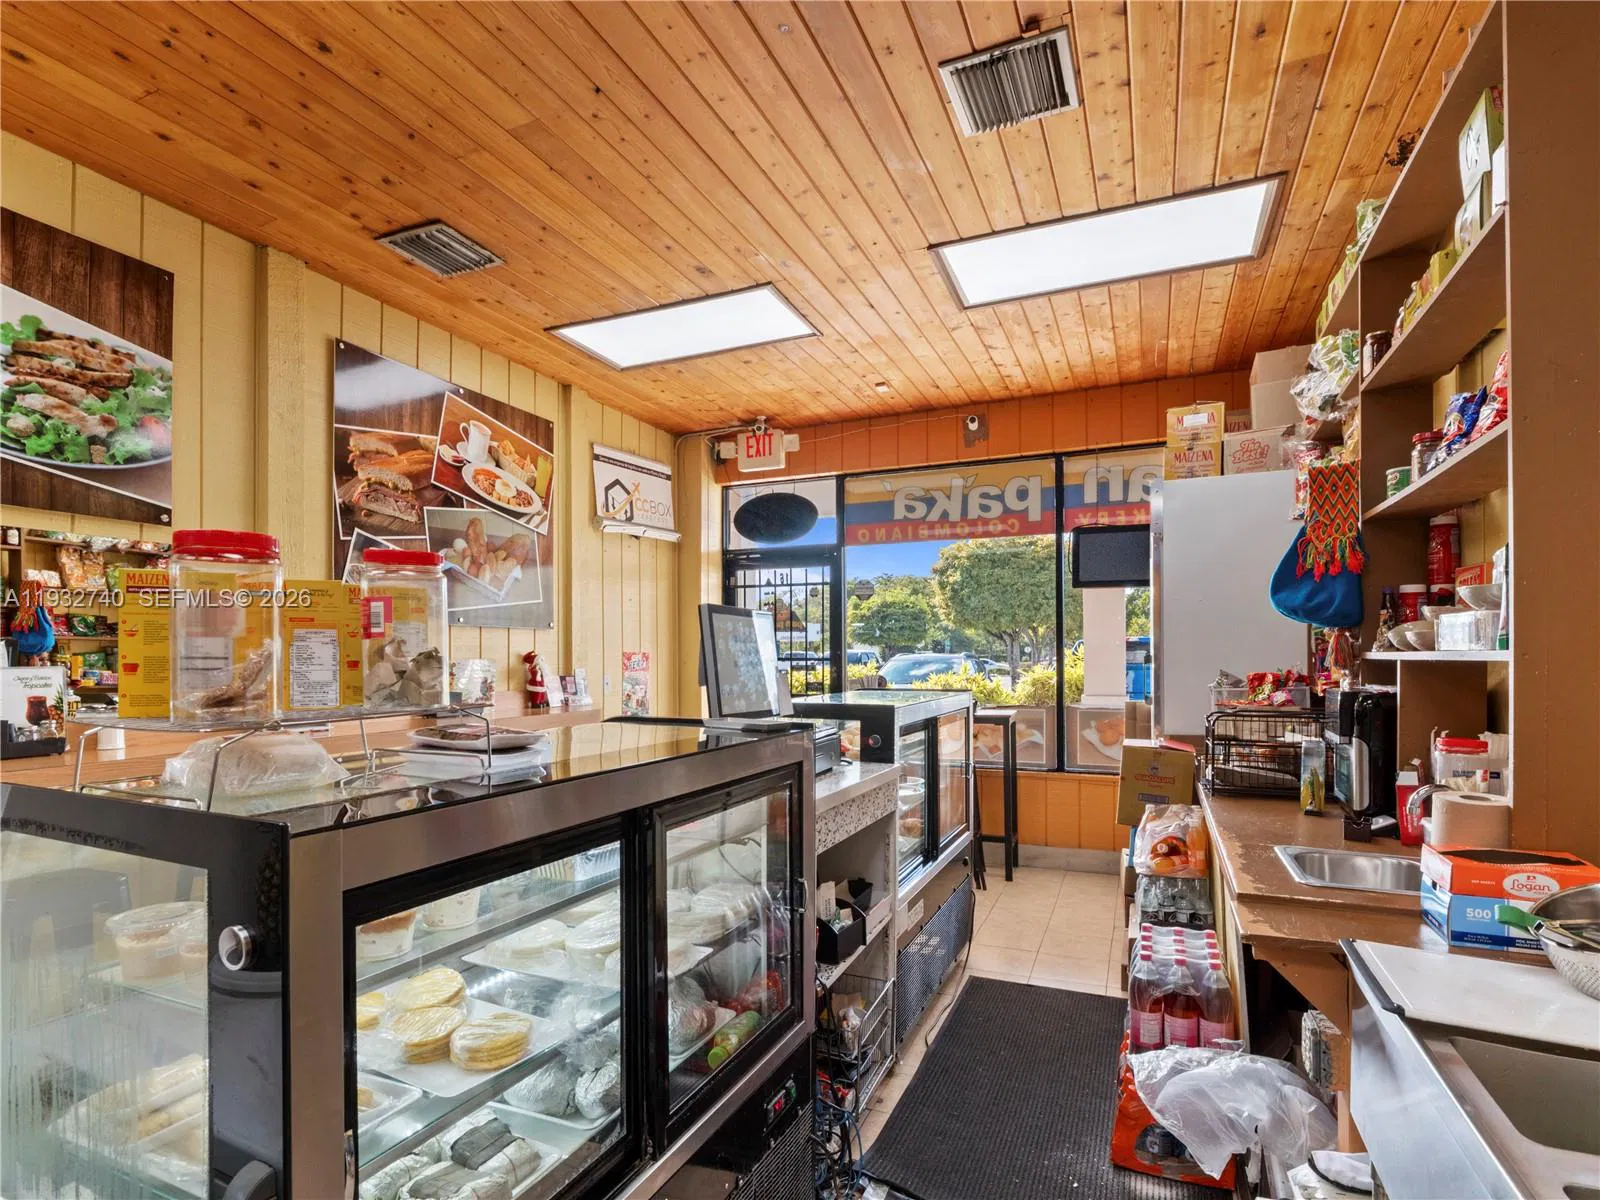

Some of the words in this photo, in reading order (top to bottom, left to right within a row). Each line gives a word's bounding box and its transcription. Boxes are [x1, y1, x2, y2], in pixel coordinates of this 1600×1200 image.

[746, 432, 773, 458] EXIT
[1173, 450, 1214, 463] MAIZENA
[126, 573, 169, 586] MAIZEN
[1510, 879, 1551, 893] Logan
[1466, 907, 1492, 919] 500
